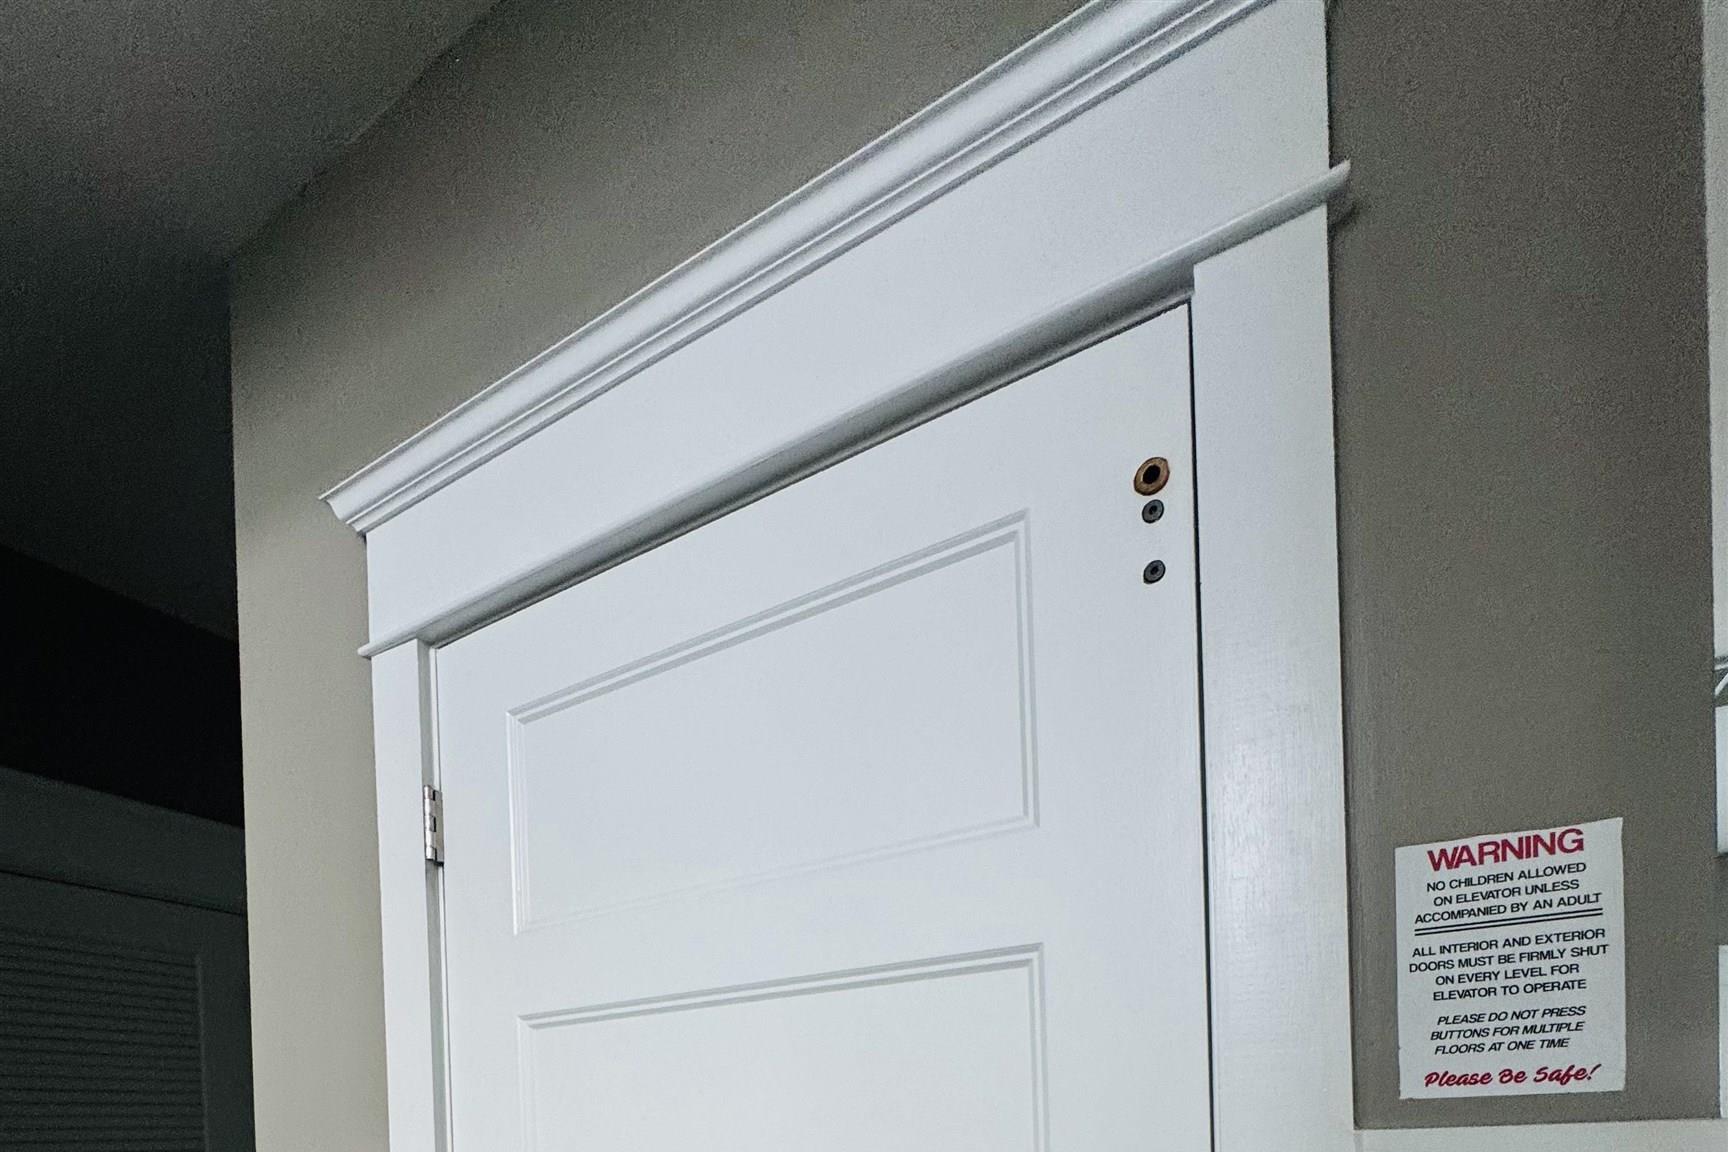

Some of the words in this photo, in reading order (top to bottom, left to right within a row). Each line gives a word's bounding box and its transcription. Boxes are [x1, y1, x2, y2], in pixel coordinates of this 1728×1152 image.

[1427, 827, 1585, 872] WARNING
[1427, 880, 1446, 893] NO
[1449, 871, 1514, 889] CHILDREN
[1518, 862, 1587, 880] ALLOWED
[1433, 893, 1453, 907] ON
[1456, 885, 1520, 904] ELEVATOR
[1525, 879, 1580, 895] UNLESS
[1415, 905, 1507, 924] ACCOMPANIED
[1511, 901, 1528, 913] BY
[1534, 897, 1553, 909] AN
[1557, 892, 1602, 907] ADULT
[1412, 945, 1436, 958] ALL
[1439, 939, 1498, 955] INTERIOR
[1502, 935, 1531, 948] AND
[1535, 928, 1606, 944] EXTERIOR
[1409, 958, 1455, 973] DOORS
[1458, 955, 1494, 969] MUST
[1498, 952, 1516, 964] BE
[1519, 947, 1566, 962] FIRMLY
[1571, 944, 1609, 957] SHUT
[1435, 972, 1455, 986] ON
[1458, 970, 1500, 983] EVERY
[1504, 966, 1547, 980] LEVEL
[1551, 963, 1580, 975] FOR
[1433, 985, 1498, 1001] ELEVATOR
[1501, 983, 1520, 995] TO
[1523, 978, 1587, 993] OPERATE
[1437, 1013, 1486, 1025] PLEASE
[1488, 1011, 1508, 1022] DO
[1511, 1008, 1539, 1020] NOT
[1542, 1005, 1586, 1017] PRESS
[1430, 1026, 1490, 1040] BUTTONS
[1493, 1024, 1519, 1037] FOR
[1522, 1021, 1585, 1034] MULTIPLE
[1435, 1042, 1485, 1055] FLOORS
[1488, 1040, 1505, 1052] AT
[1507, 1039, 1534, 1050] ONE
[1539, 1037, 1570, 1049] TIME
[1424, 1069, 1493, 1088] Please
[1499, 1068, 1527, 1083] Be
[1534, 1064, 1602, 1085] Safe!
